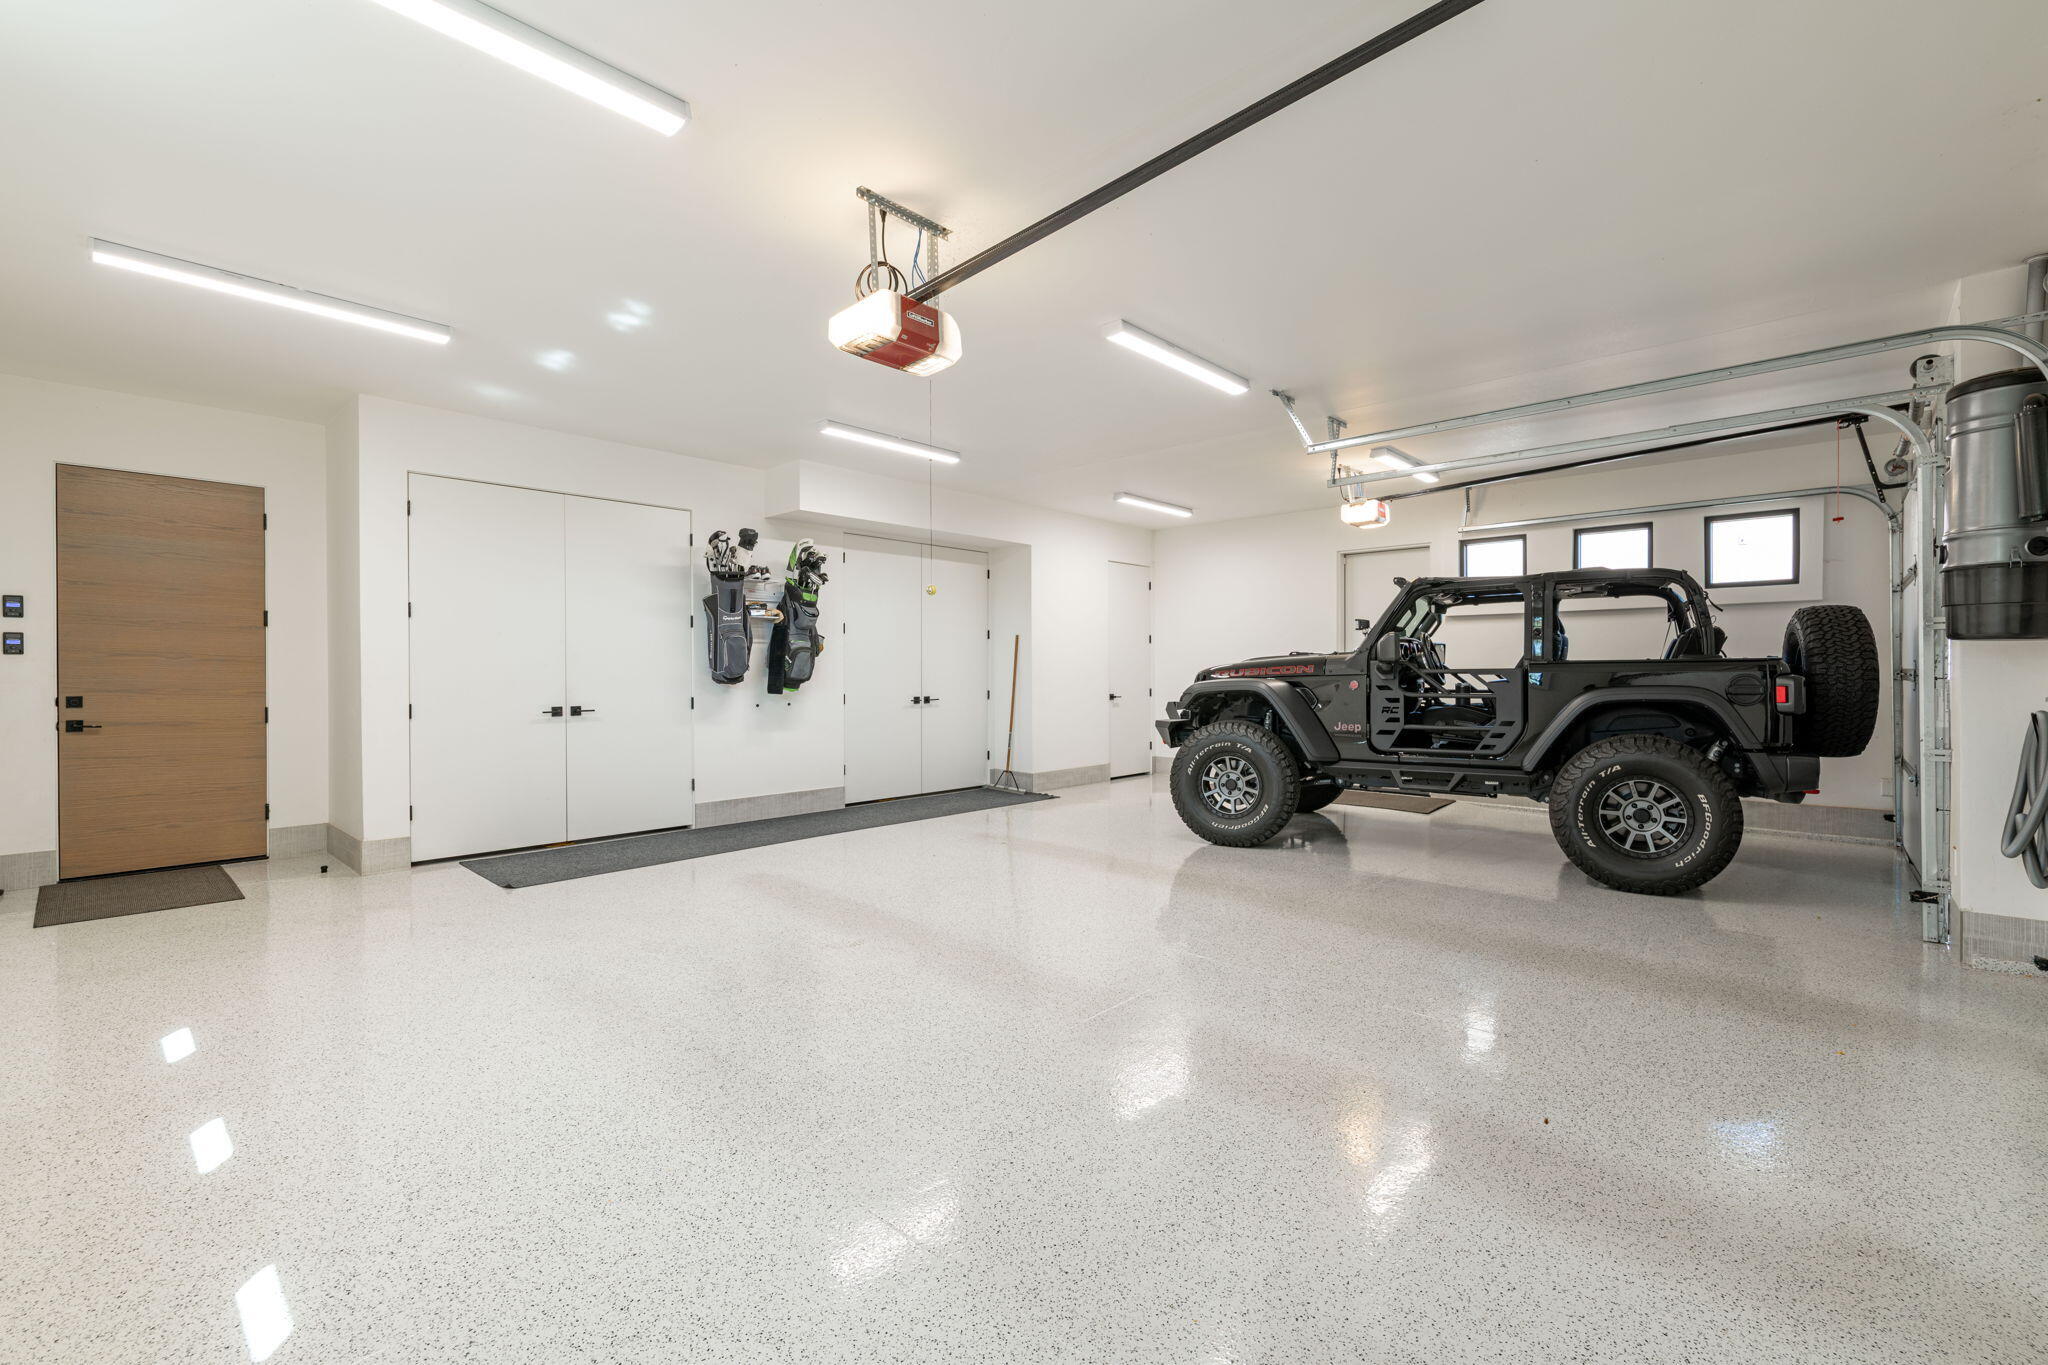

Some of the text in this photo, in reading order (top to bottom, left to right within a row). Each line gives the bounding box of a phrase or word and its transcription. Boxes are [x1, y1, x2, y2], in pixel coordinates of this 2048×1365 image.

[1334, 722, 1362, 733] Jeep
[1236, 742, 1252, 754] T/A
[1599, 764, 1622, 778] T/A
[1211, 803, 1269, 830] BFGoodrich
[1674, 793, 1713, 868] BFGoodrich
